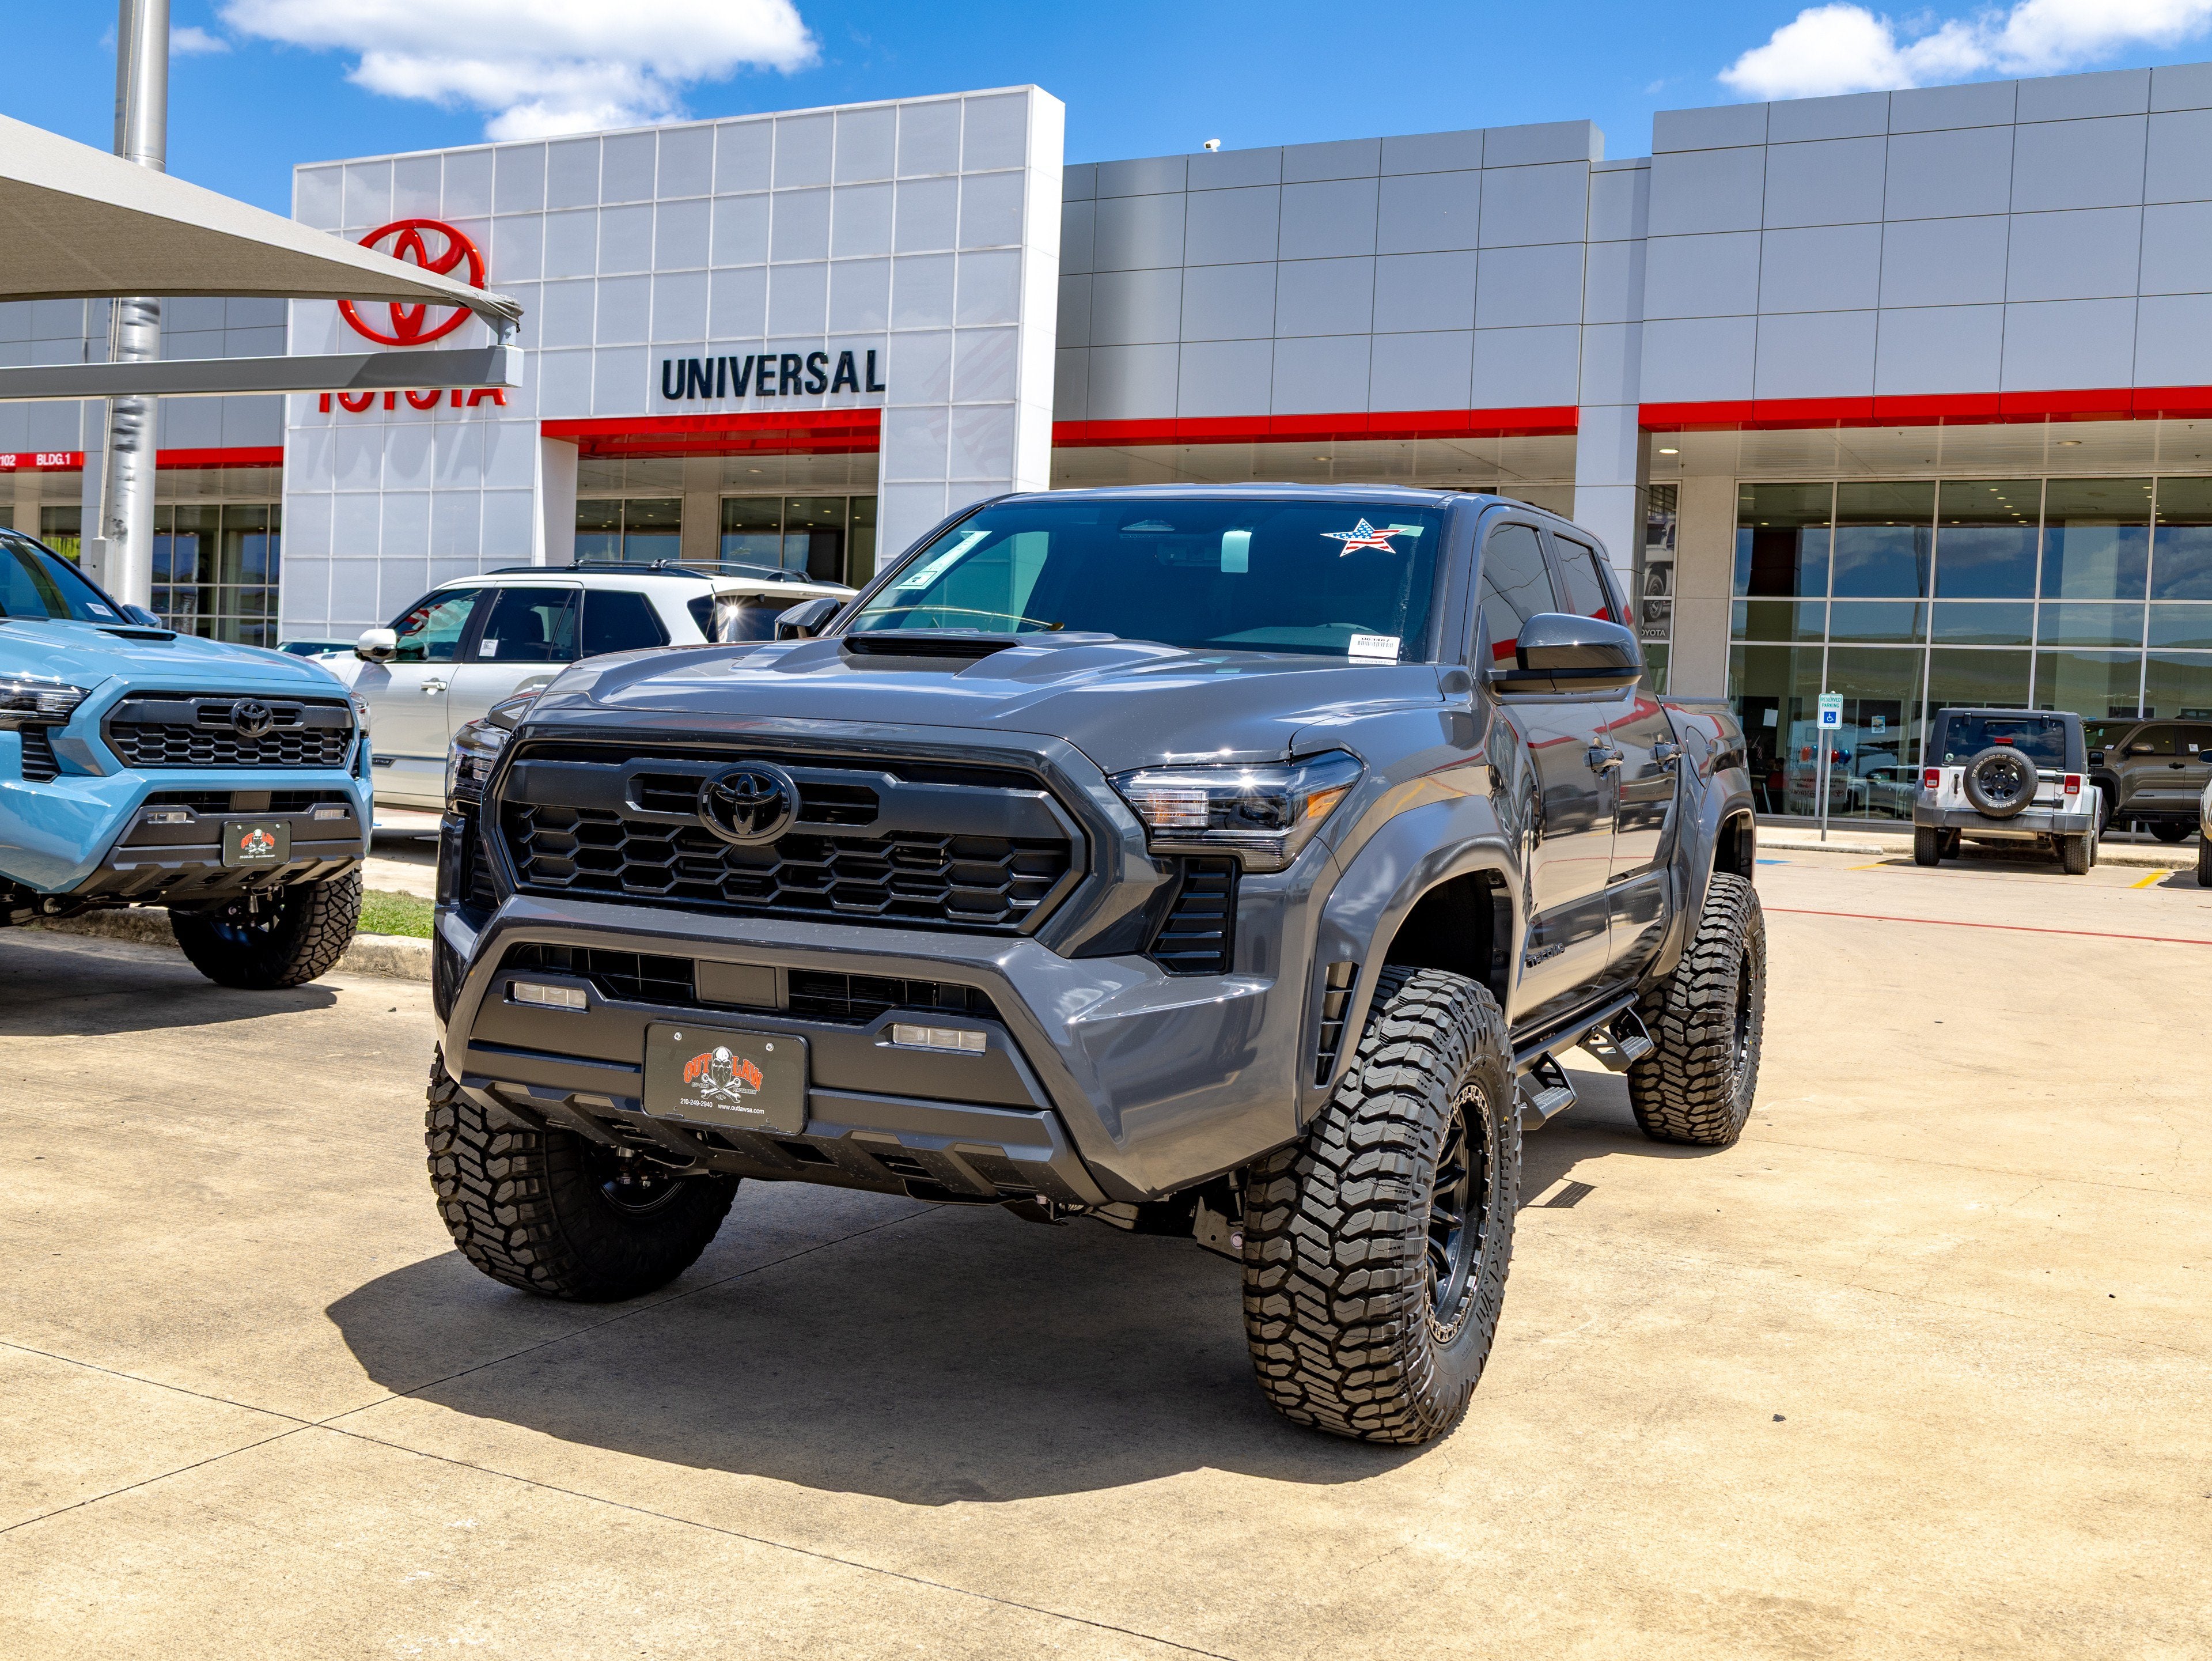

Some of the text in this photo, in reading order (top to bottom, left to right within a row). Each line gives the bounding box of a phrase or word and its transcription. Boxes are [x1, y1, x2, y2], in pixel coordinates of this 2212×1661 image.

[662, 350, 885, 400] UNIVERSAL
[0, 455, 16, 466] 102
[1525, 943, 1565, 968] TACOMA
[680, 1098, 764, 1114] 210-249-2940 www.outlawsa.com
